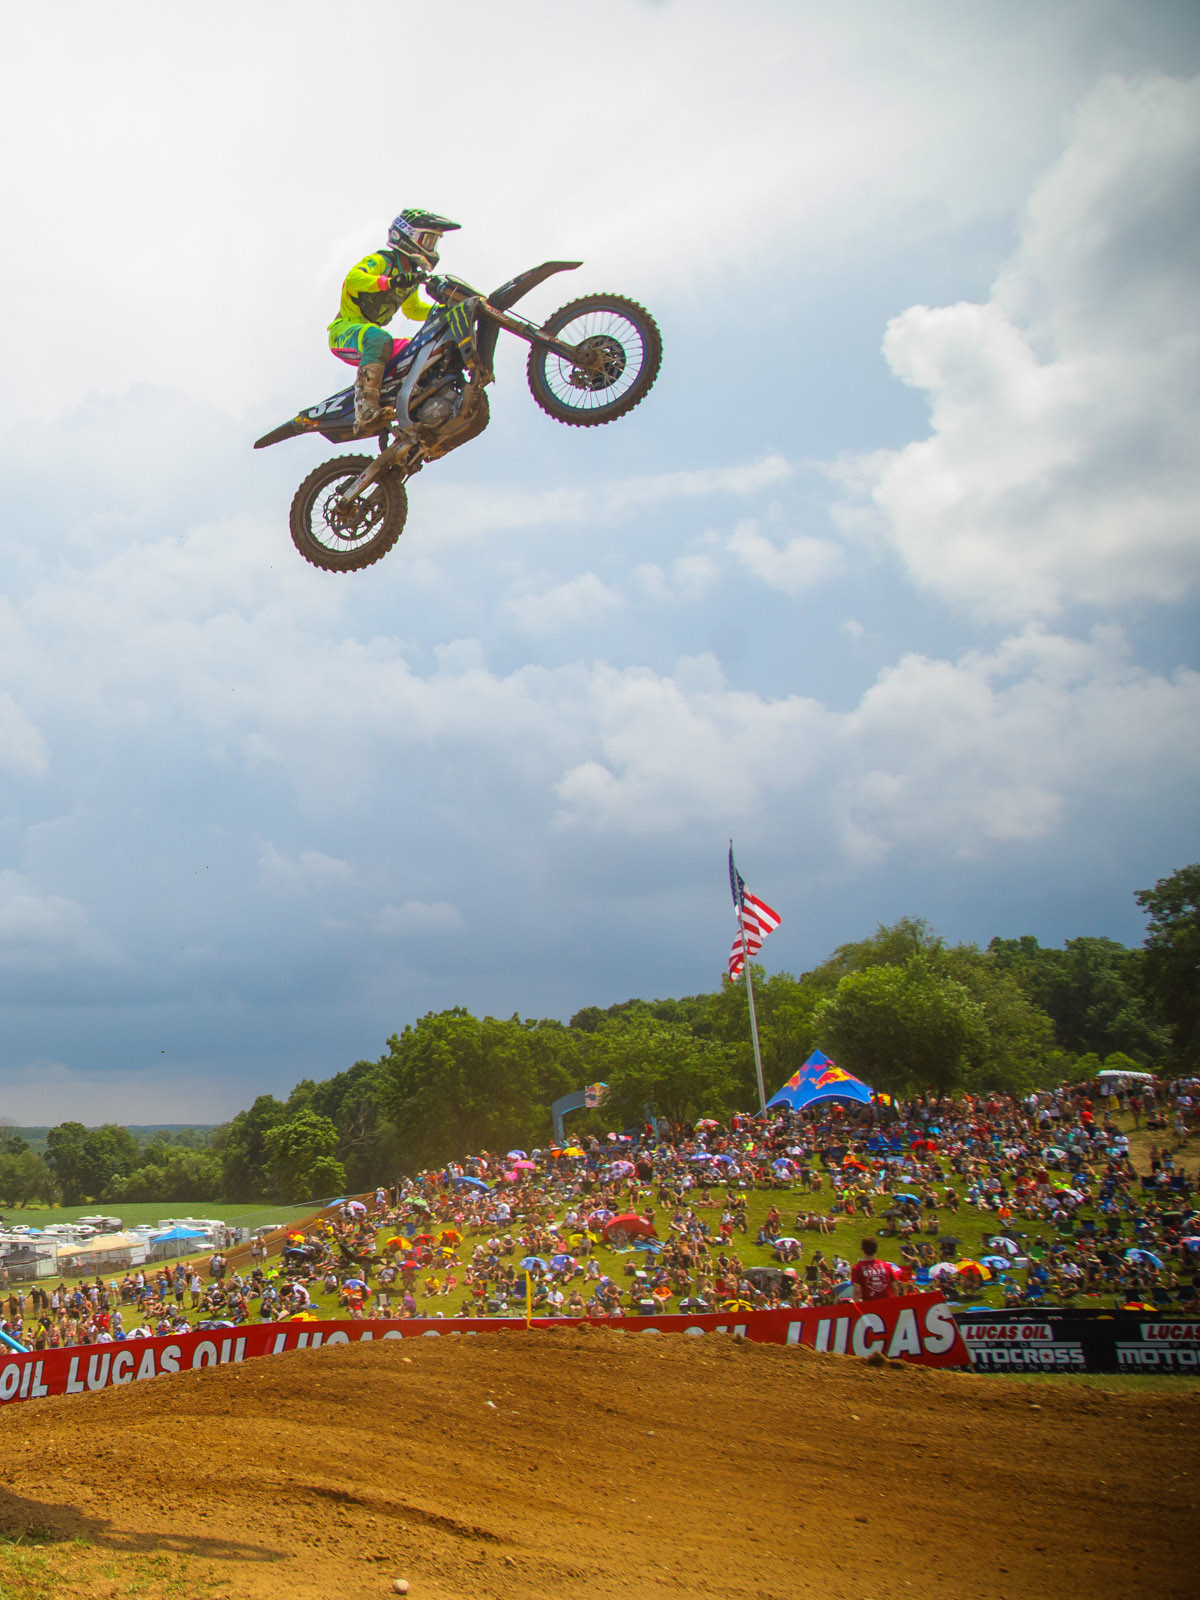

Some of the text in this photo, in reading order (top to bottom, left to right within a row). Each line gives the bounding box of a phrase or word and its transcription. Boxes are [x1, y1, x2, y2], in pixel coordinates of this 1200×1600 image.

[394, 216, 415, 237] 00%
[966, 1325, 1049, 1339] LUCAS OIL
[1116, 1349, 1200, 1364] MOTO
[65, 1345, 182, 1394] LUCAS
